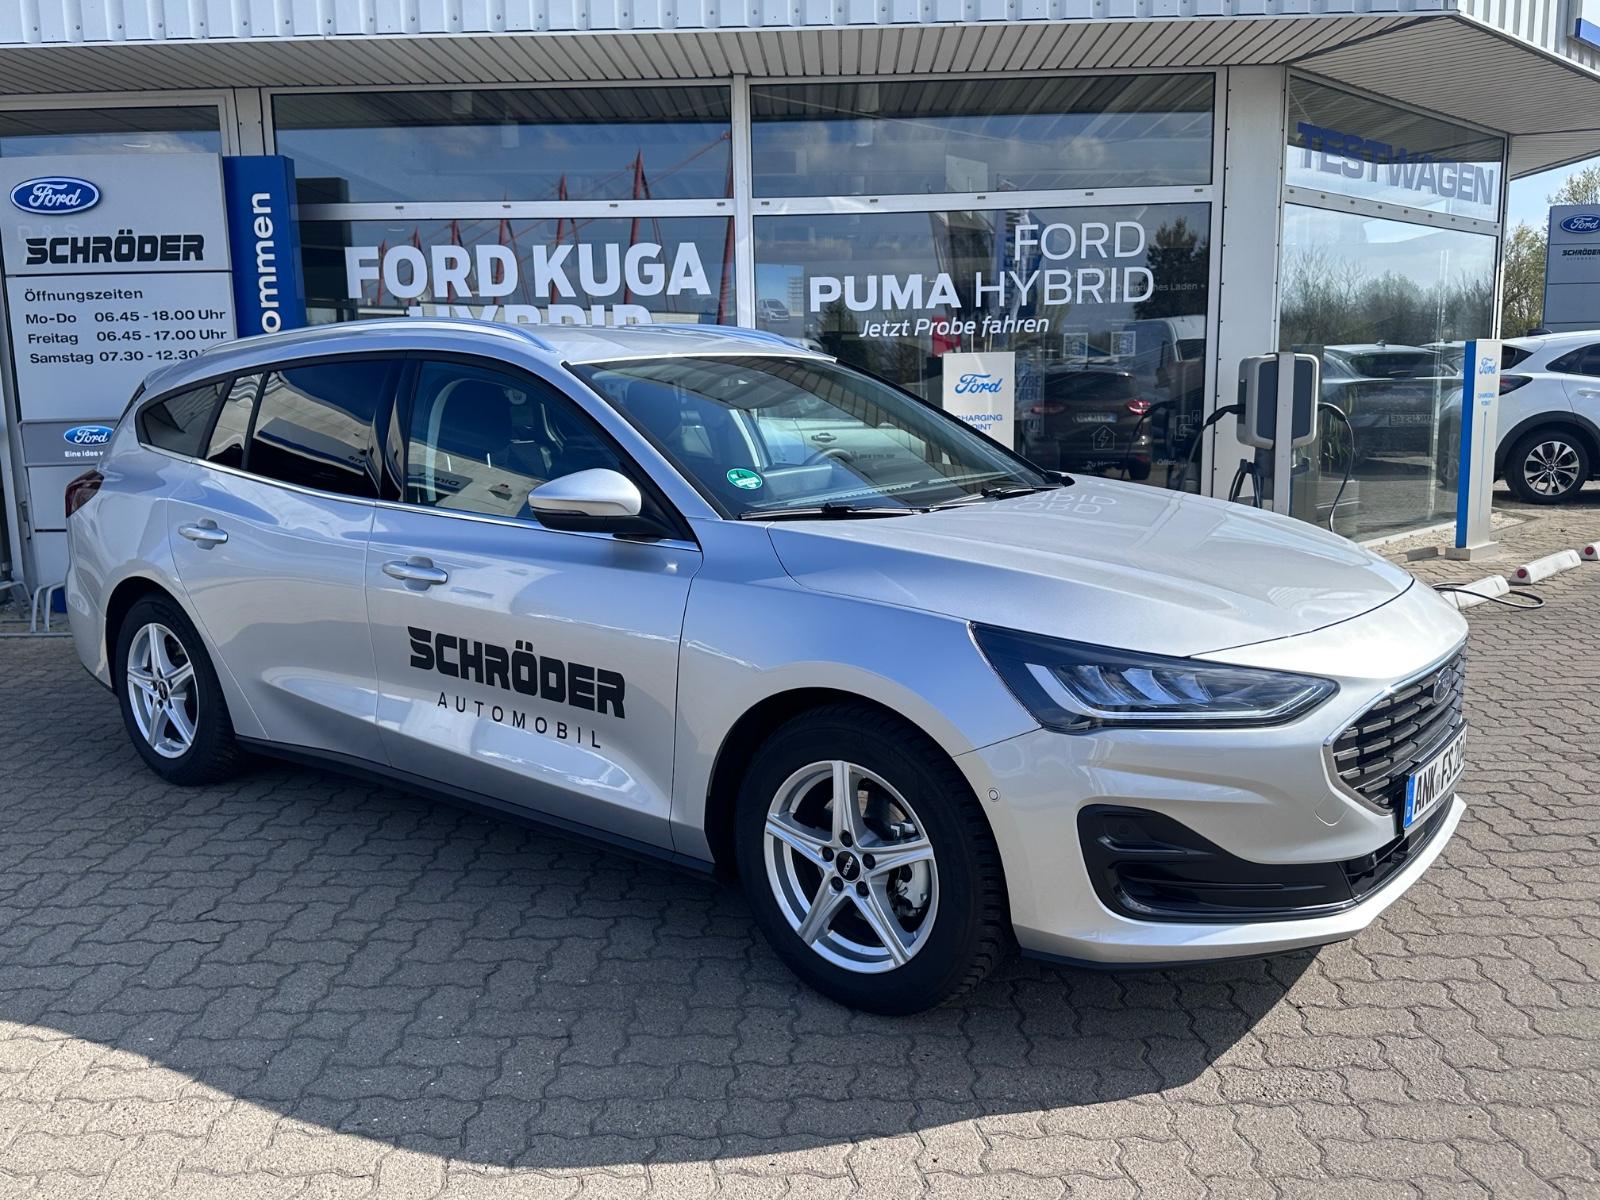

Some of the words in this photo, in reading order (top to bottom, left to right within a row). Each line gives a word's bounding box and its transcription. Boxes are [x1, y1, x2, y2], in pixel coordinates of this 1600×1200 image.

[1298, 121, 1494, 205] TESTWAGEN
[28, 183, 81, 207] Ford
[1570, 217, 1600, 229] Ford
[26, 229, 205, 265] SCHRÖDER
[1014, 221, 1146, 261] FORD
[345, 243, 519, 299] FORD
[532, 242, 712, 298] KUGA
[24, 288, 143, 303] Öffnungszeiten
[810, 272, 962, 313] PUMA
[976, 266, 1154, 308] HYBRID
[25, 313, 77, 325] Mo-Do
[94, 311, 140, 322] 06.45
[152, 310, 195, 321] 18.00
[198, 309, 226, 320] Uhr
[859, 318, 909, 338] Jetzt
[914, 316, 975, 336] Probe
[980, 315, 1050, 337] fahren
[28, 333, 79, 345] Freitag
[96, 330, 142, 342] 06.45
[153, 329, 196, 340] 17.00
[199, 329, 227, 340] Uhr
[30, 352, 94, 365] Samstag
[99, 351, 144, 362] 07.30
[156, 349, 199, 360] 12.30
[955, 373, 1003, 394] Ford
[74, 428, 108, 443] Ford
[972, 423, 992, 431] OINT
[407, 626, 625, 719] SCHRÖDER
[437, 691, 601, 749] AUTOMOBIL
